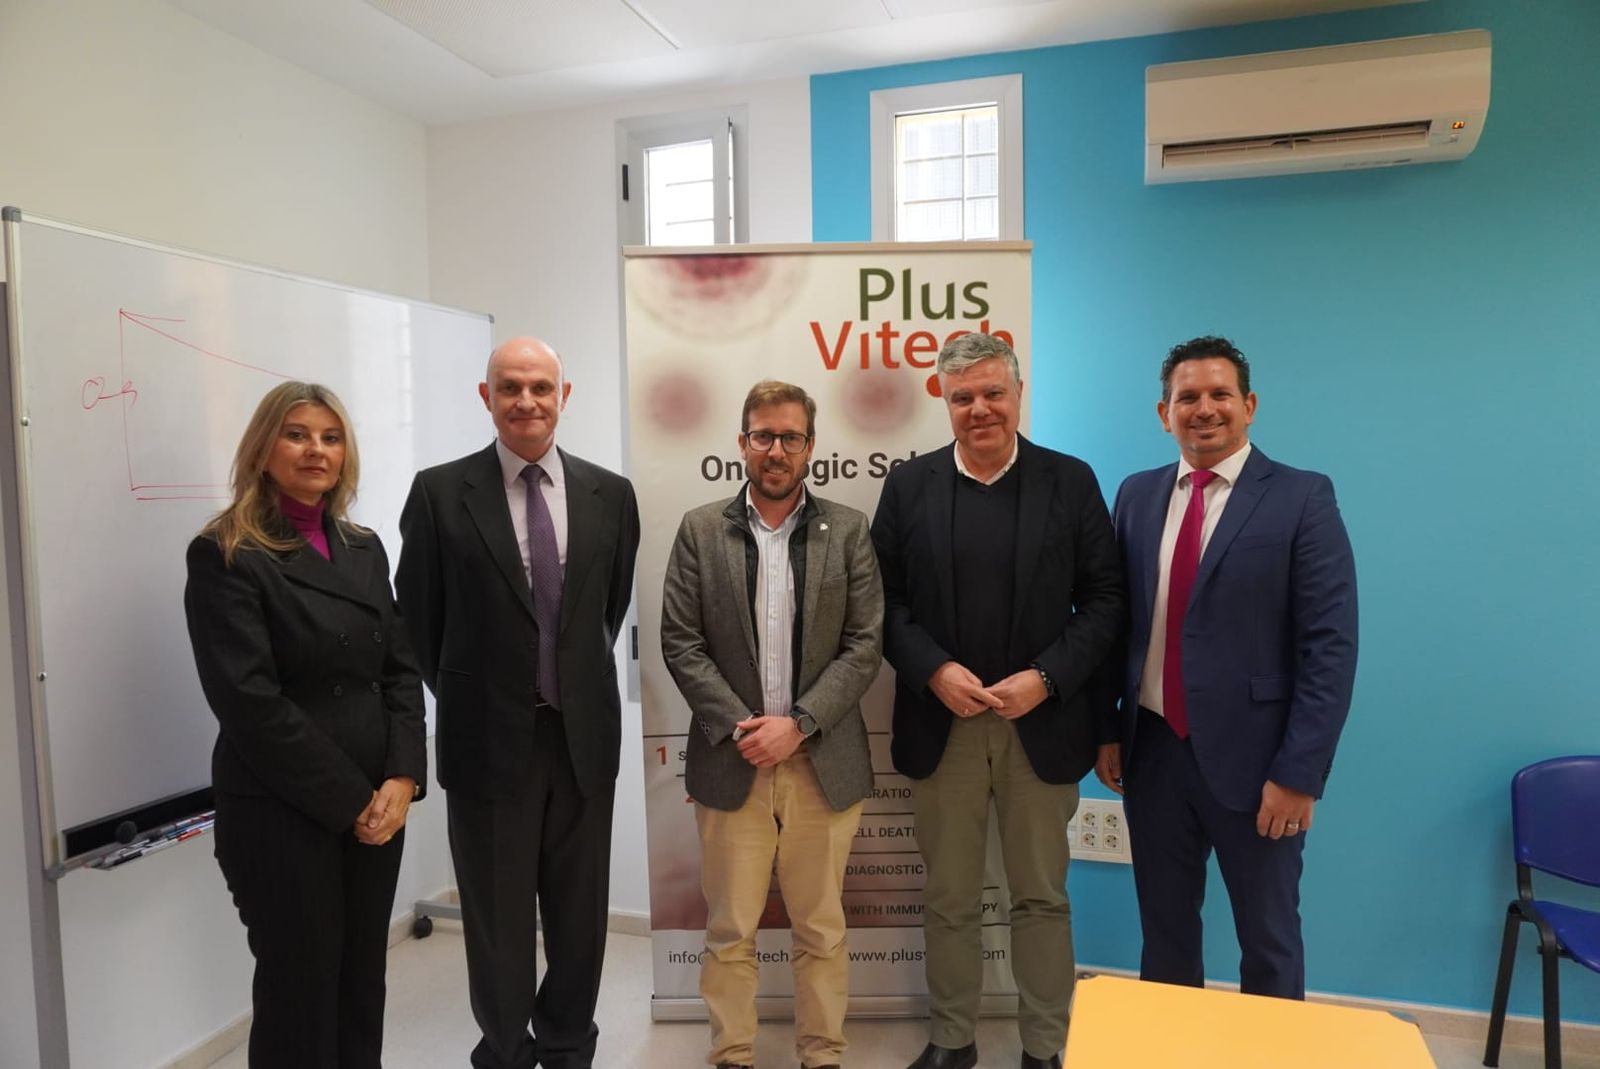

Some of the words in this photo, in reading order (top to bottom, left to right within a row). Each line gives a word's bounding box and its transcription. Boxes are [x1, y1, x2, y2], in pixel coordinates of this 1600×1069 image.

[859, 268, 990, 321] Plus
[809, 320, 1014, 370] Vite
[701, 453, 858, 486] Ongic
[656, 746, 666, 765] 1
[866, 788, 912, 799] RATIO
[846, 864, 923, 875] DIAGNOSTIC
[850, 904, 882, 915] WITH
